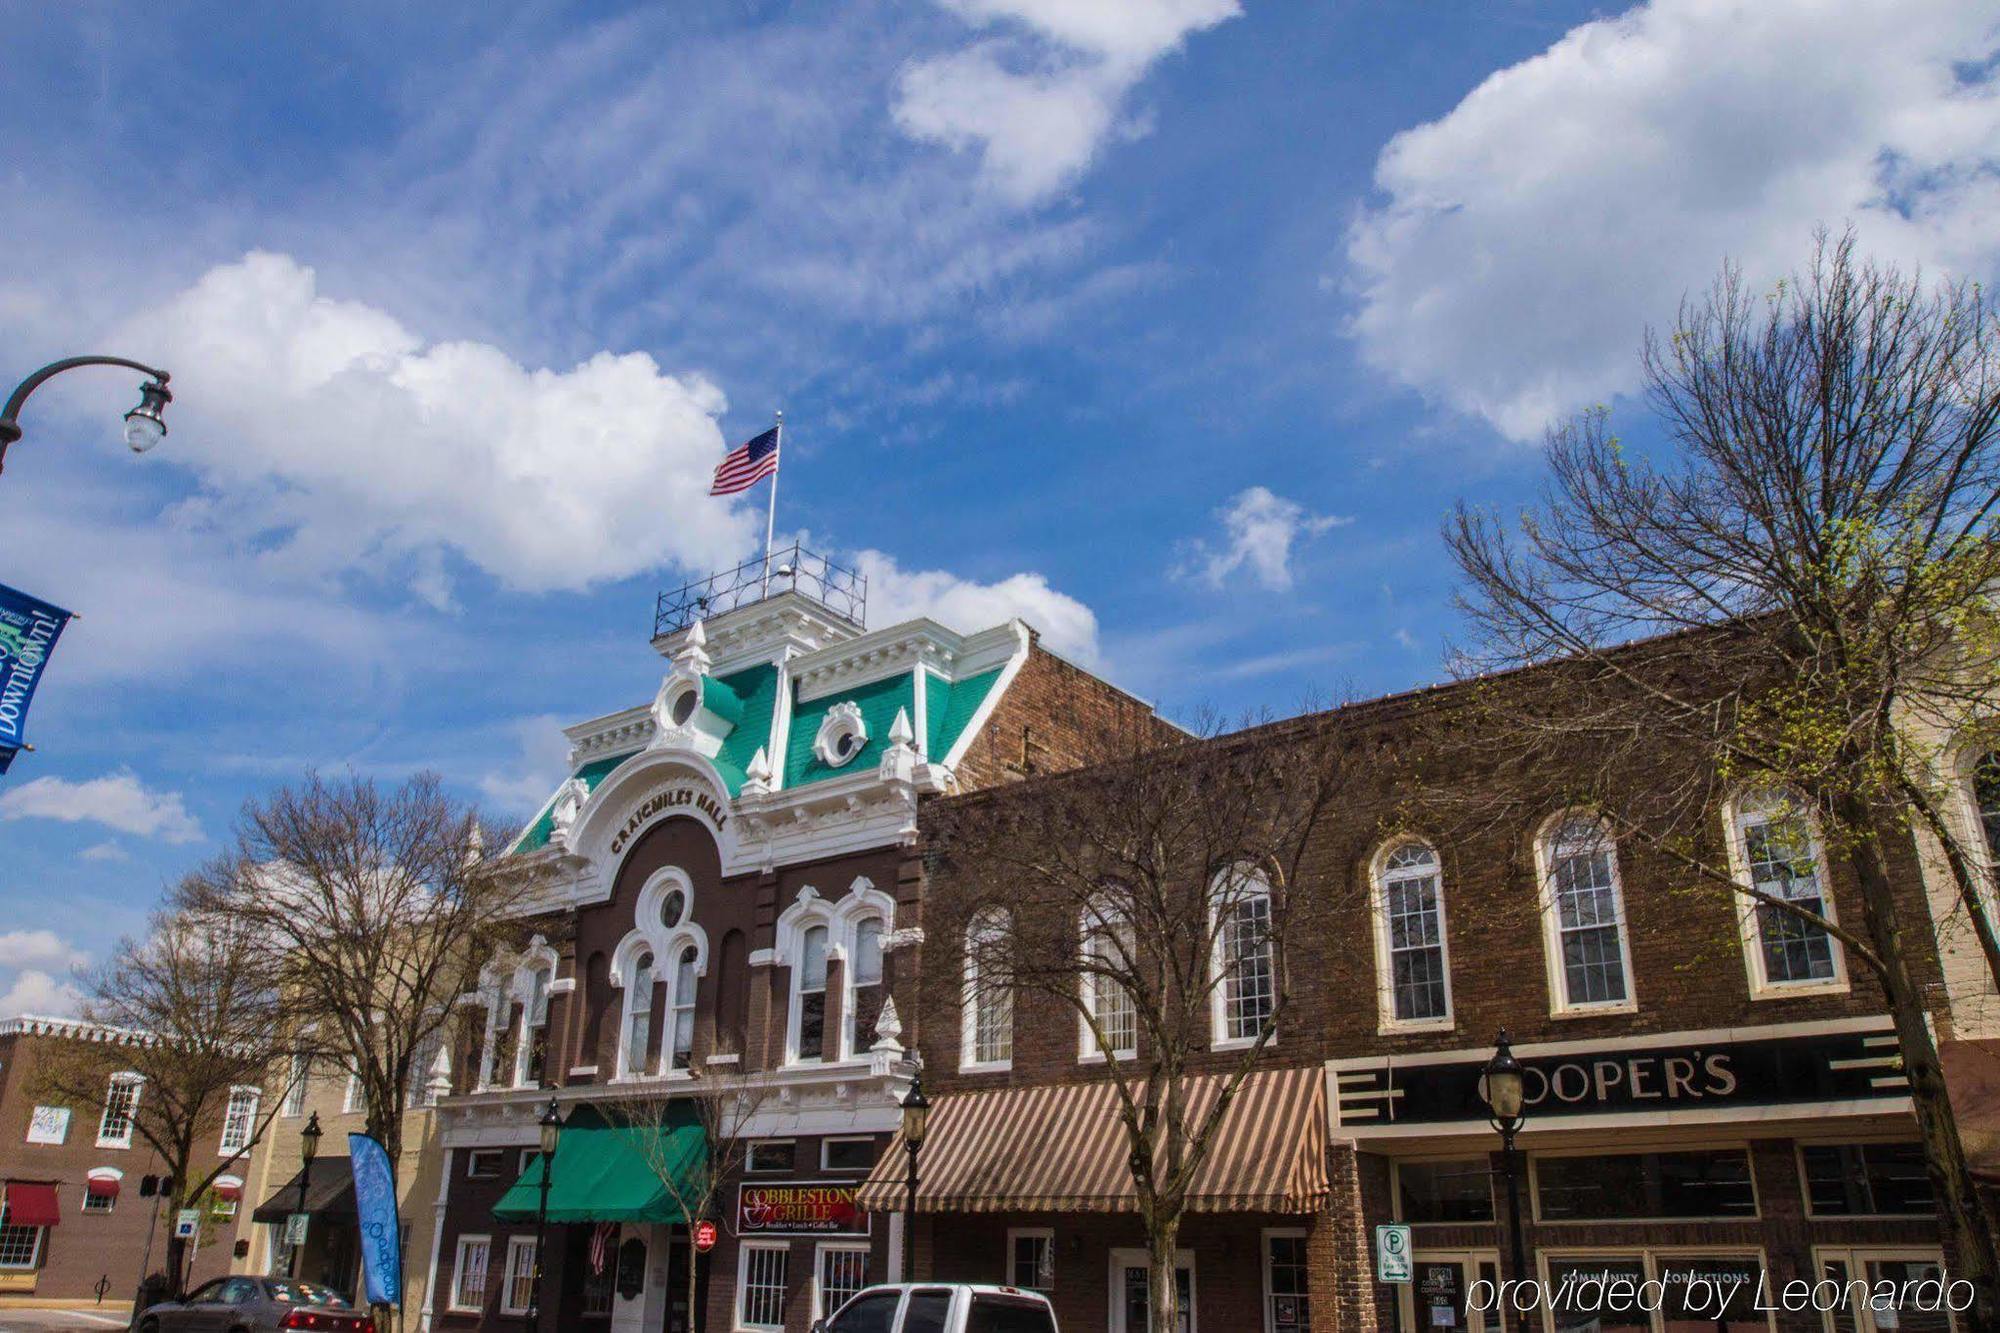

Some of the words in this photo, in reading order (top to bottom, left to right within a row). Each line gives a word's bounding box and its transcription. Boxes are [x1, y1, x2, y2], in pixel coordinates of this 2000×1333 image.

[695, 793, 728, 832] HALL
[773, 1204, 832, 1221] GRILLE
[1561, 1272, 1639, 1285] COMMUNITY
[1665, 1272, 1751, 1285] CORRECTIONS
